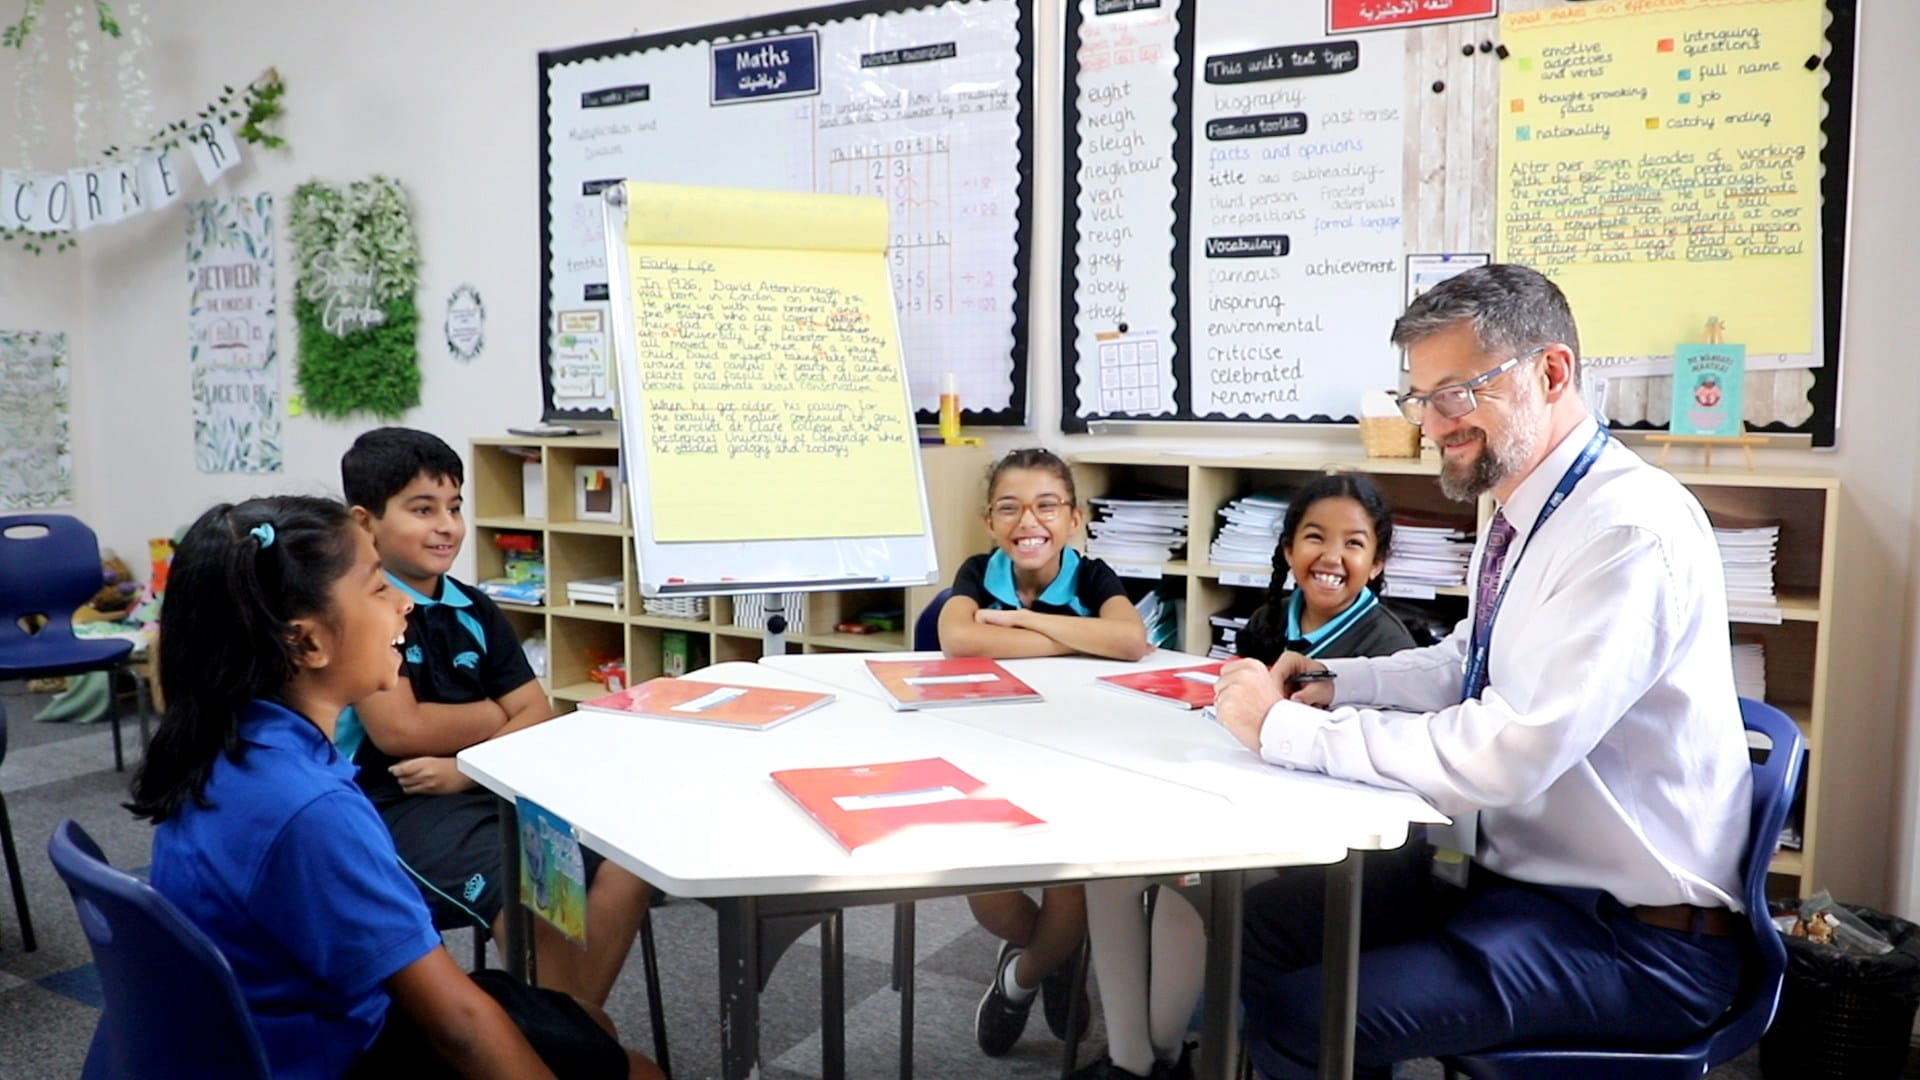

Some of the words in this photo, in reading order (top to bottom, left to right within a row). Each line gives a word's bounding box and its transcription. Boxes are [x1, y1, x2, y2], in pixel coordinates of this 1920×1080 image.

[1683, 27, 1761, 43] intriguing
[1542, 41, 1602, 57] emotive
[1683, 39, 1760, 57] questions
[736, 44, 790, 71] Maths
[1207, 60, 1243, 77] This
[1248, 52, 1284, 72] unit's
[1291, 50, 1318, 66] text
[1323, 49, 1355, 70] type
[1543, 53, 1613, 70] adjectives
[1541, 68, 1566, 80] and
[1571, 66, 1604, 78] verbs
[1699, 63, 1726, 81] full
[1739, 61, 1781, 74] name
[1088, 80, 1131, 108] eight
[1697, 91, 1721, 108] job
[1560, 102, 1594, 119] facts
[1725, 112, 1772, 127] ending
[1258, 116, 1301, 133] toolkit
[1536, 122, 1611, 140] nationality
[1088, 129, 1145, 156] sleigh
[1209, 147, 1250, 169] facts
[1262, 144, 1290, 160] and
[1299, 140, 1363, 159] opinions
[1740, 156, 1793, 171] around
[1084, 156, 1163, 184] neighbour
[1510, 160, 1549, 176] After
[1208, 169, 1246, 187] title
[1089, 186, 1124, 203] vein
[1092, 203, 1124, 222] veil
[1088, 226, 1133, 248] reign
[1207, 238, 1282, 256] Vocabulary
[640, 256, 679, 273] Early
[687, 257, 716, 274] Life
[1088, 253, 1124, 276] grey
[713, 279, 752, 291] David
[1209, 266, 1281, 293] famous
[1305, 259, 1397, 276] achievement
[1088, 278, 1128, 303] obey
[1086, 303, 1126, 324] they
[1208, 295, 1285, 316] inspiring
[1207, 314, 1324, 337] environmental
[1210, 383, 1300, 405] renowned
